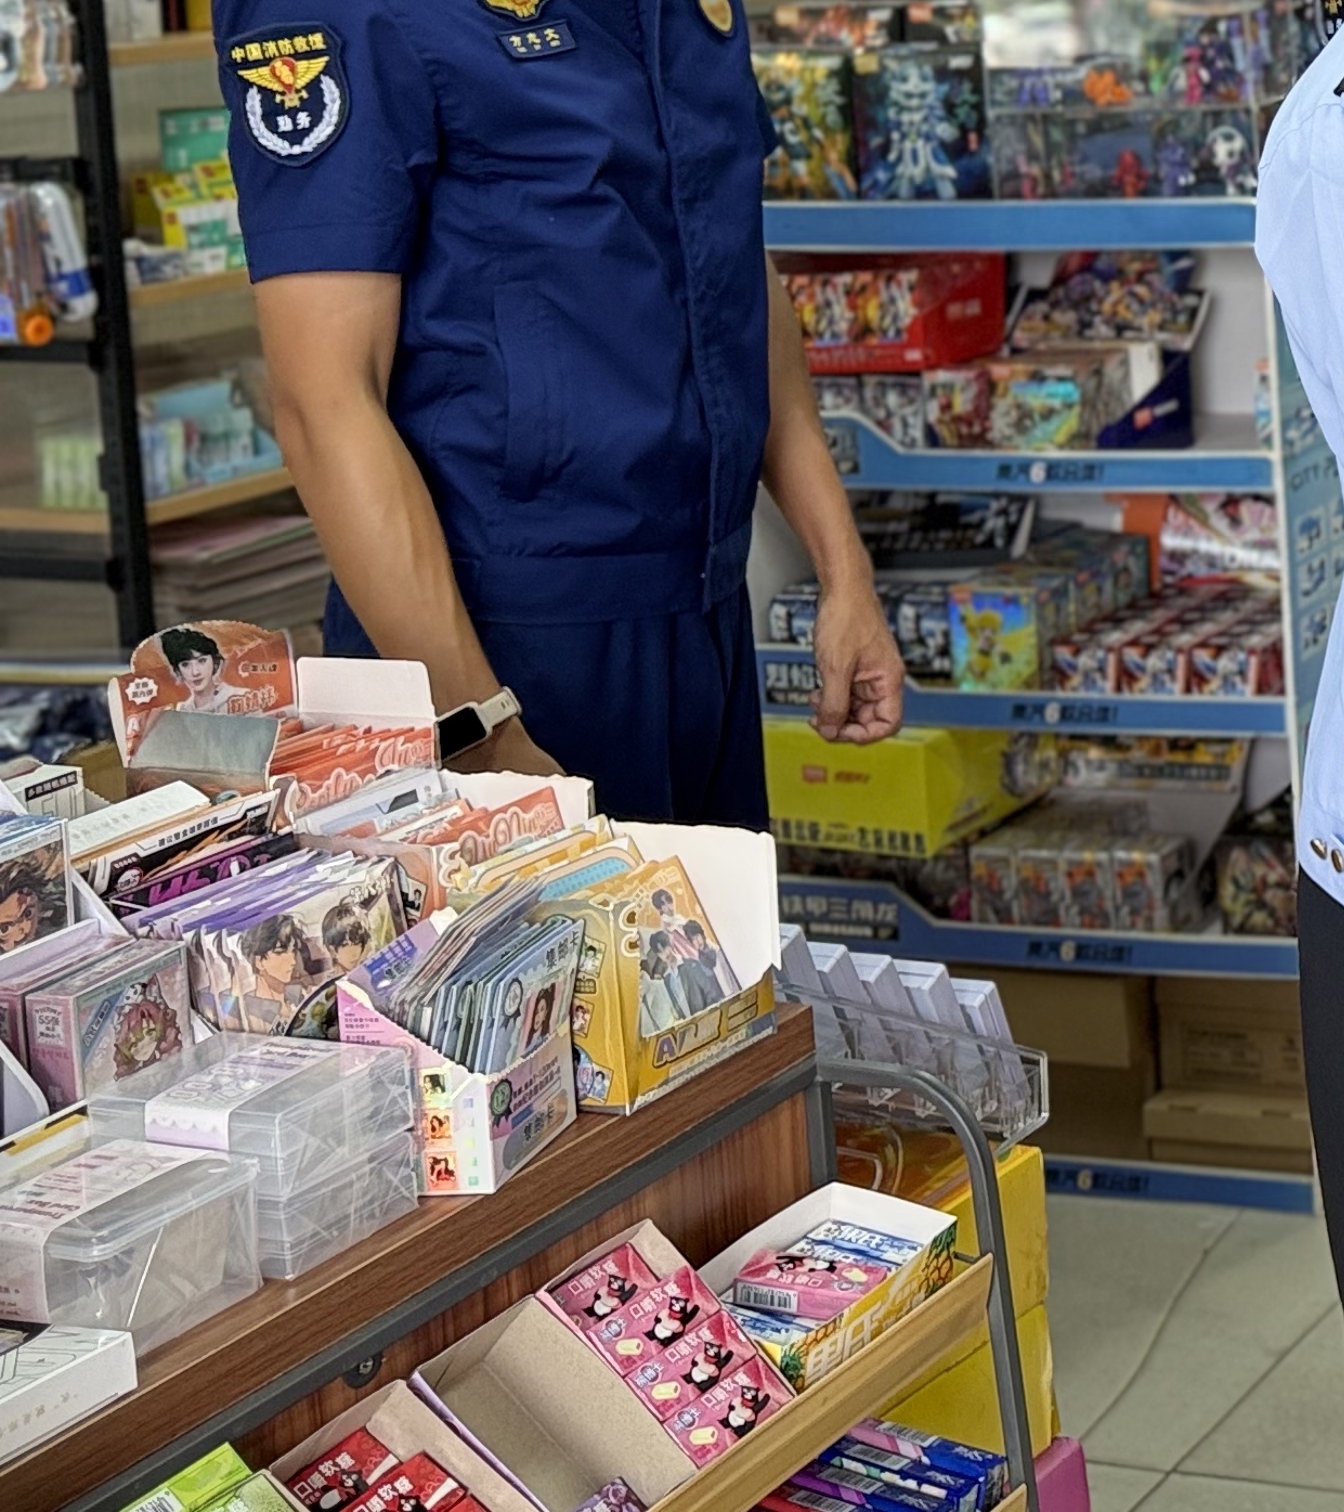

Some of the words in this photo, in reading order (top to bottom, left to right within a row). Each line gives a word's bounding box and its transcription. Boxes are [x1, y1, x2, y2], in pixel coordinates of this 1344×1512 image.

[231, 32, 326, 63] 中国消防救援
